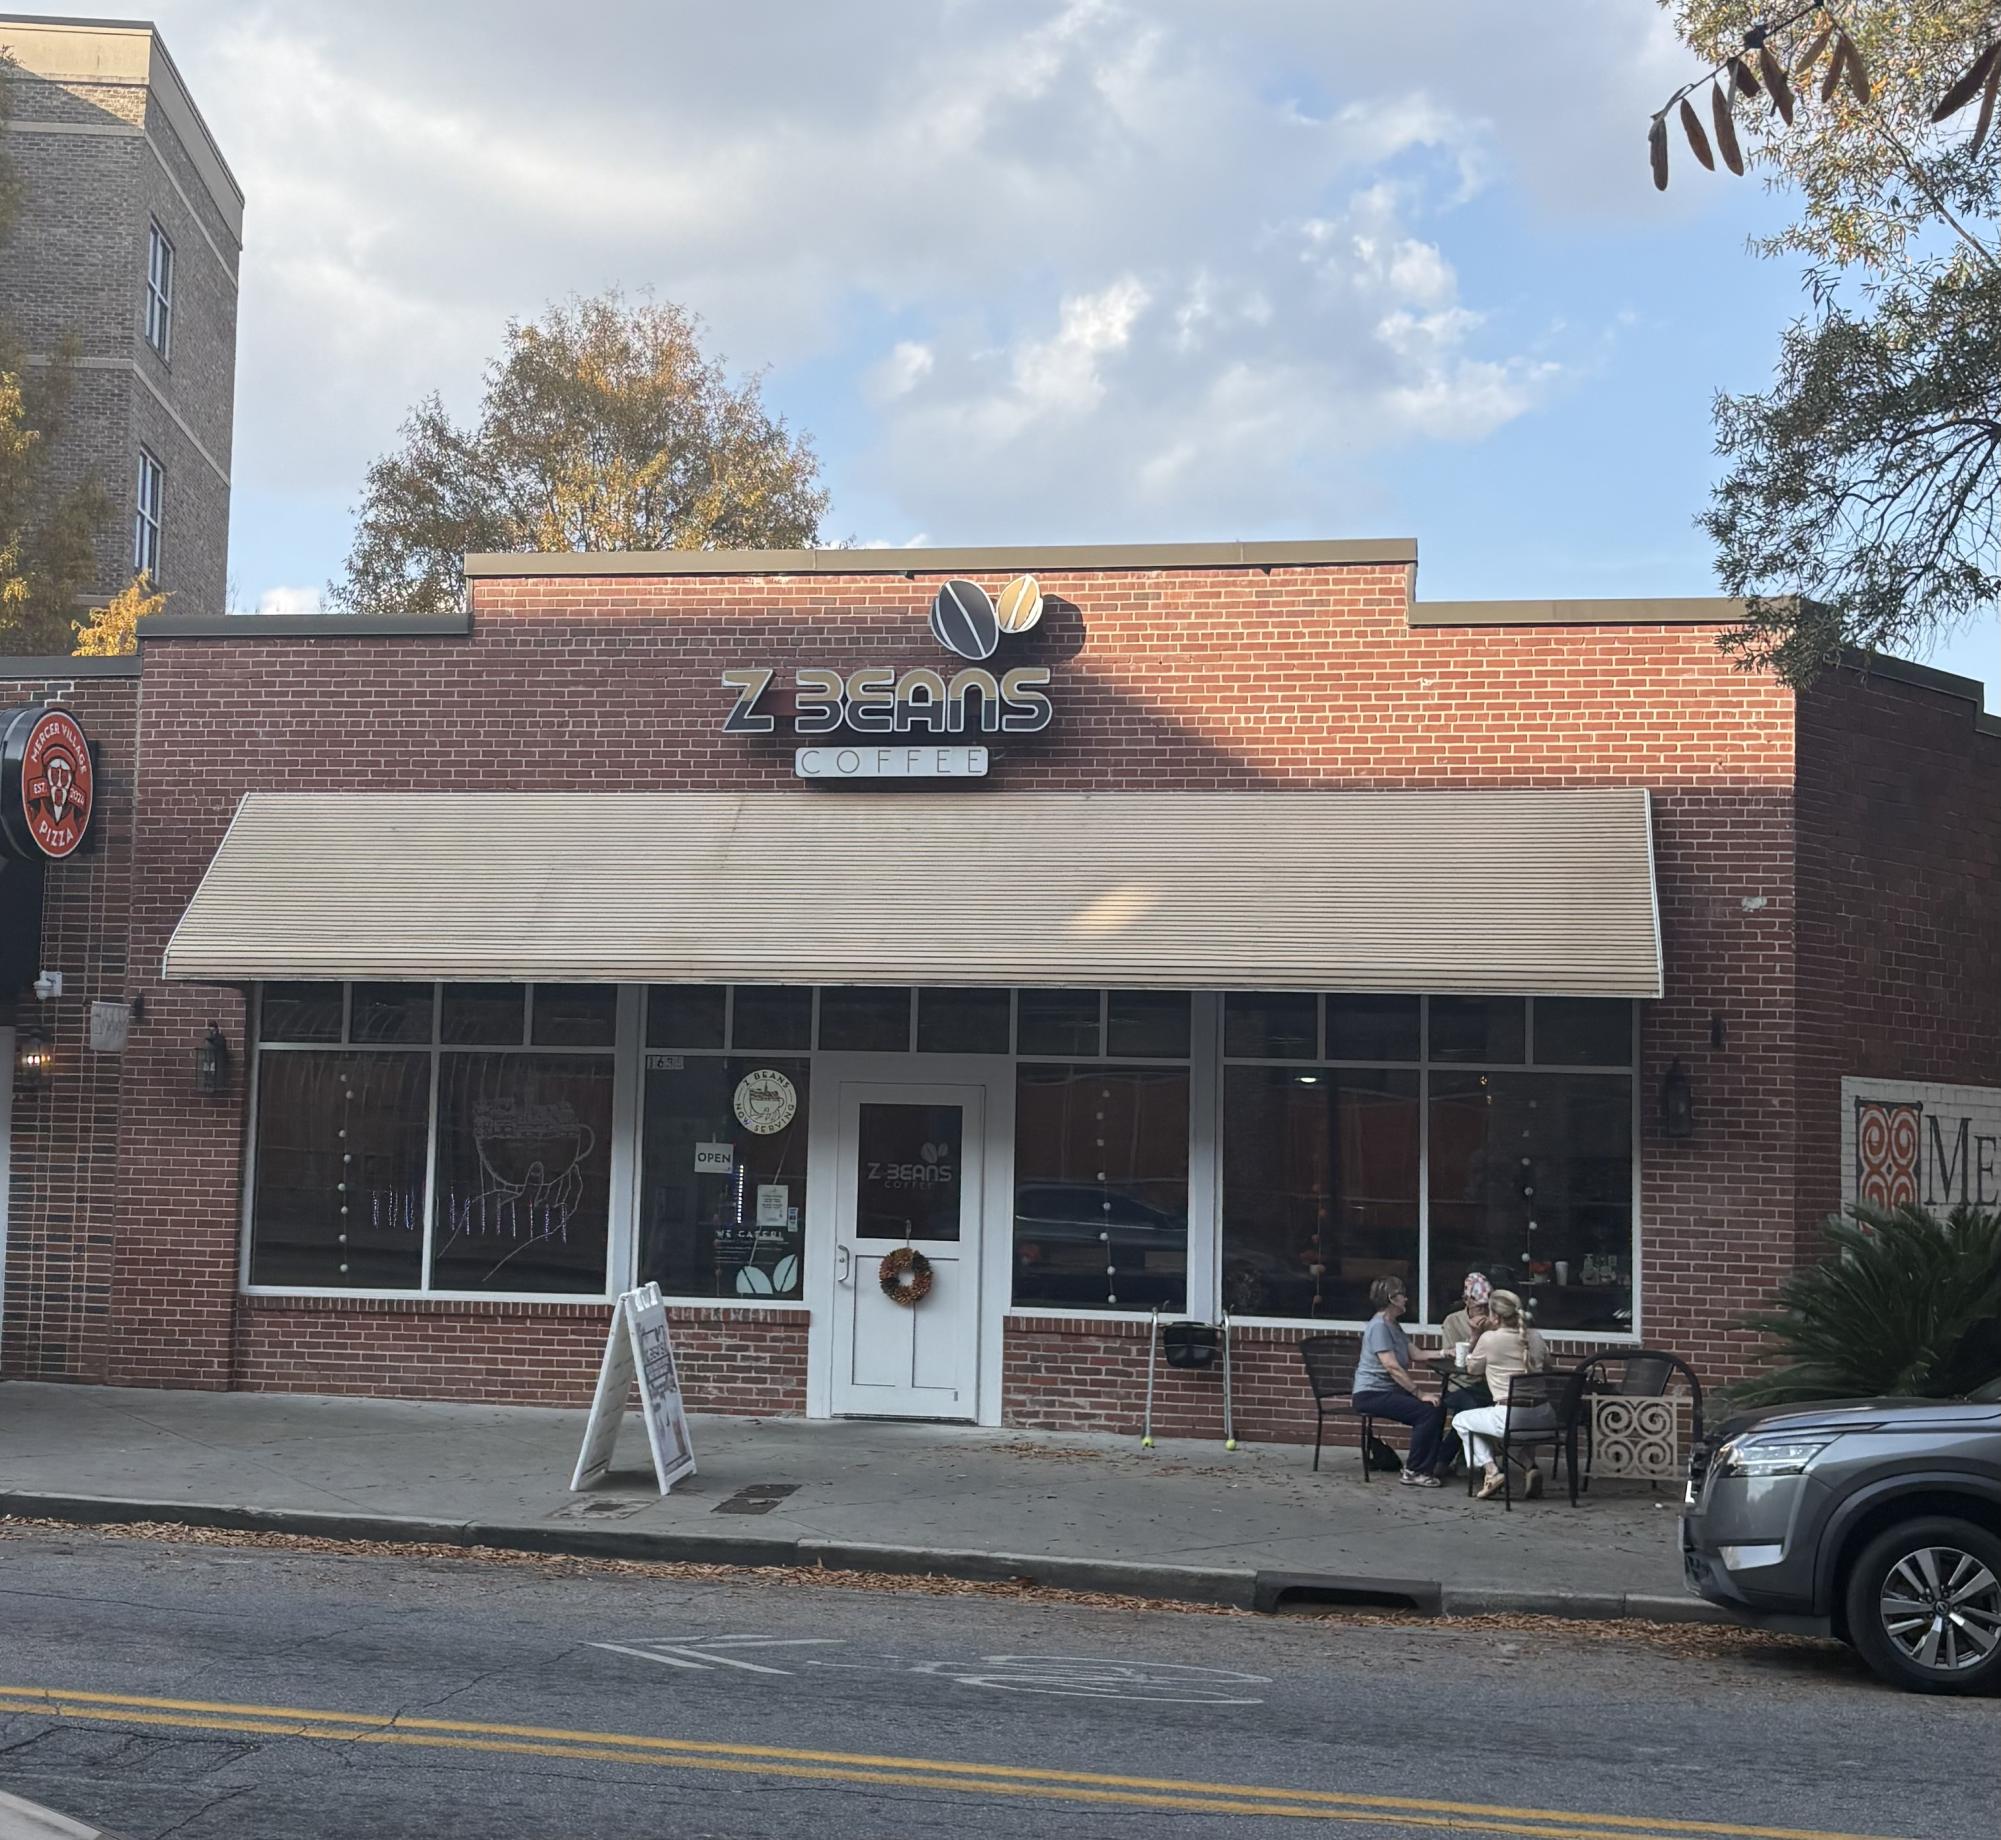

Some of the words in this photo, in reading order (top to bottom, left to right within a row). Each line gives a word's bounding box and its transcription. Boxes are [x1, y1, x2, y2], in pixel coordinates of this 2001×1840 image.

[722, 668, 775, 733] Z
[795, 667, 1053, 733] BEANS
[31, 722, 60, 763] MERCER
[61, 723, 88, 775] VILLAGE
[800, 748, 983, 775] COFFEE
[39, 820, 74, 848] PIZZA
[753, 1071, 790, 1089] BEANS
[735, 1103, 752, 1126] NOW
[753, 1104, 795, 1133] SERVING
[697, 1152, 731, 1164] OPEN
[867, 1162, 881, 1180] Z
[887, 1163, 952, 1182] BEANS
[1923, 1114, 2001, 1207] ME
